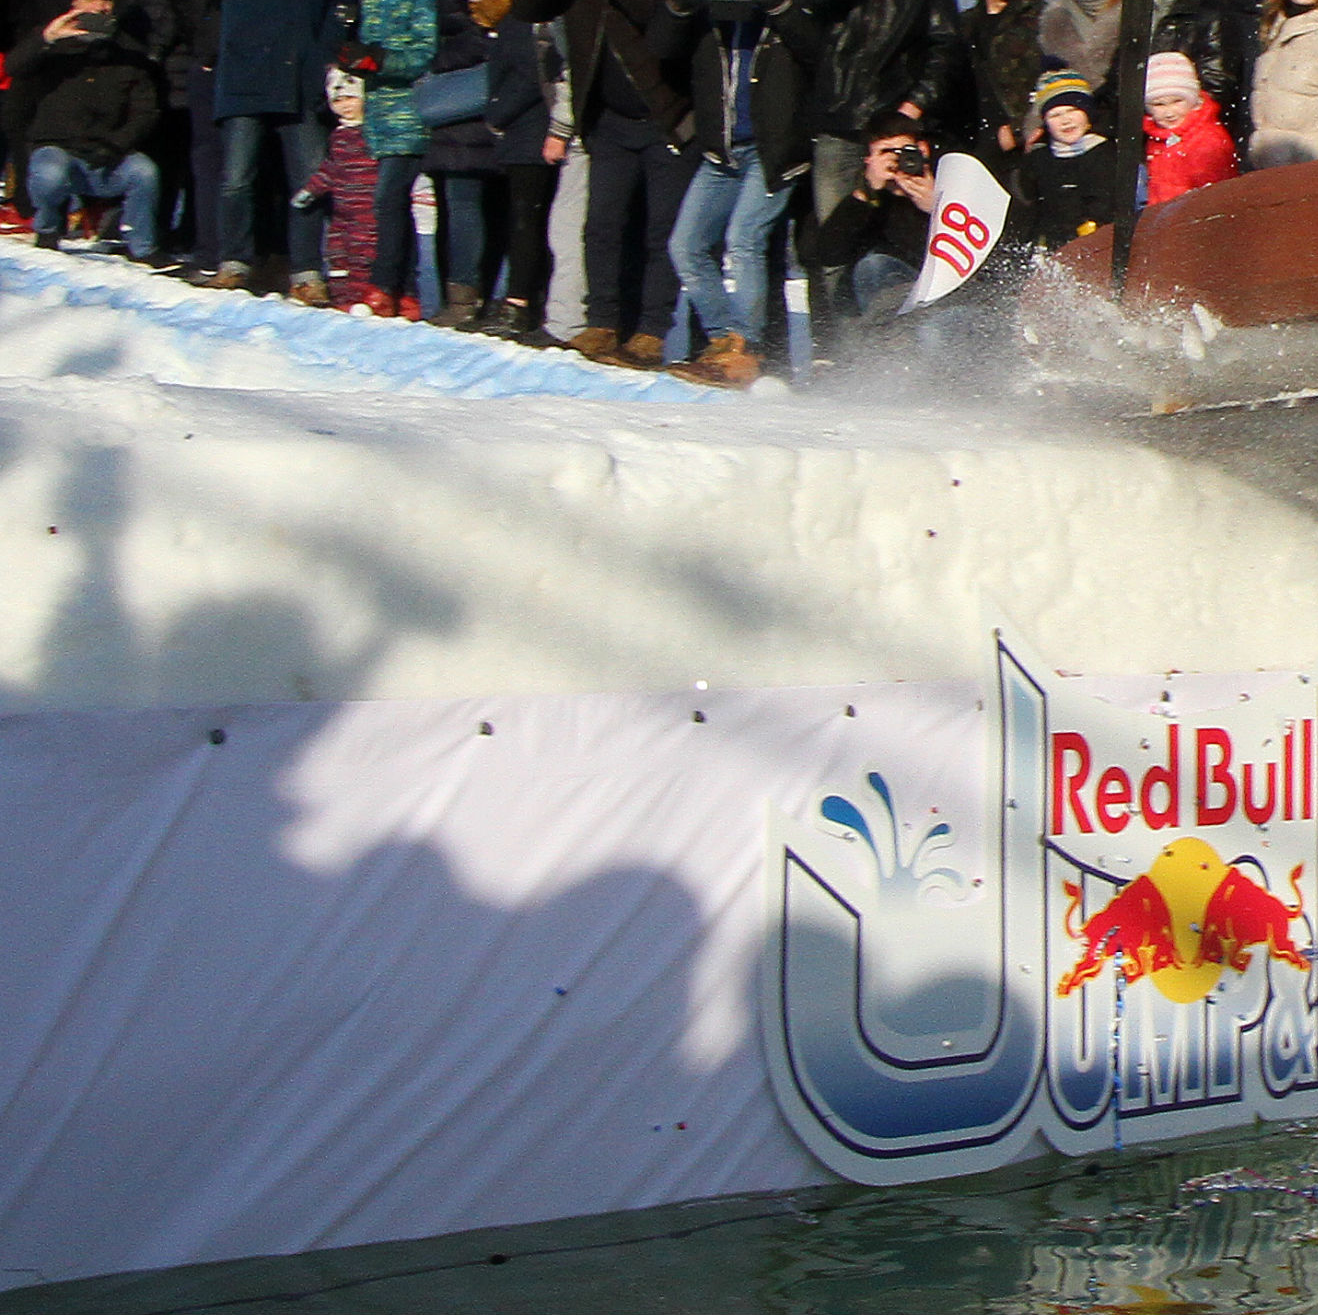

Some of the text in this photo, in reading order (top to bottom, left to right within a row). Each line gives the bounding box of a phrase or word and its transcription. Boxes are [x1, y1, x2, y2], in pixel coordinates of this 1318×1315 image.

[928, 201, 991, 279] 08
[1051, 718, 1314, 836] Red Bull
